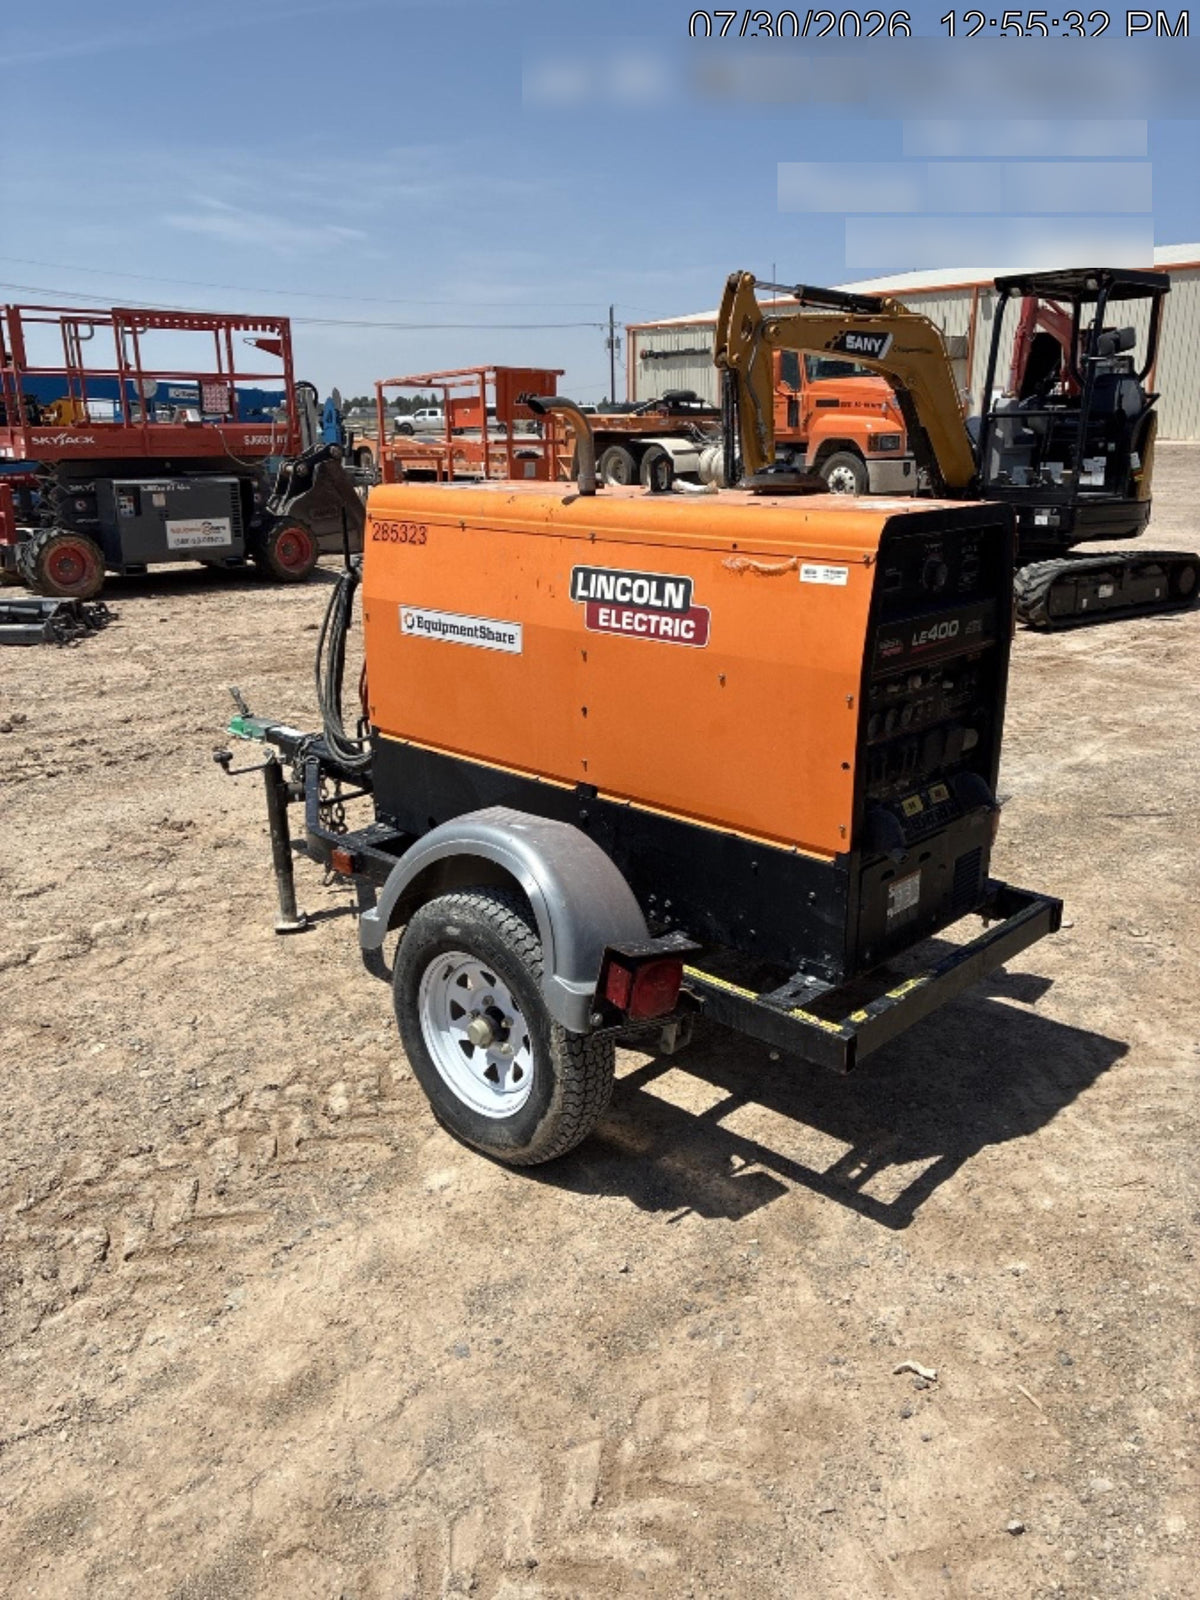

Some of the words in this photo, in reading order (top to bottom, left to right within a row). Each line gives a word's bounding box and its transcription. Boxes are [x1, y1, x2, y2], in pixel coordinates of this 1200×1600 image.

[846, 334, 882, 353] SANY
[31, 432, 96, 446] SKYJACK
[372, 521, 428, 546] 285323
[576, 571, 686, 609] LINCOLN
[416, 614, 516, 645] EquipmentShare
[598, 607, 696, 640] ELECTRIC
[911, 619, 960, 646] LE400
